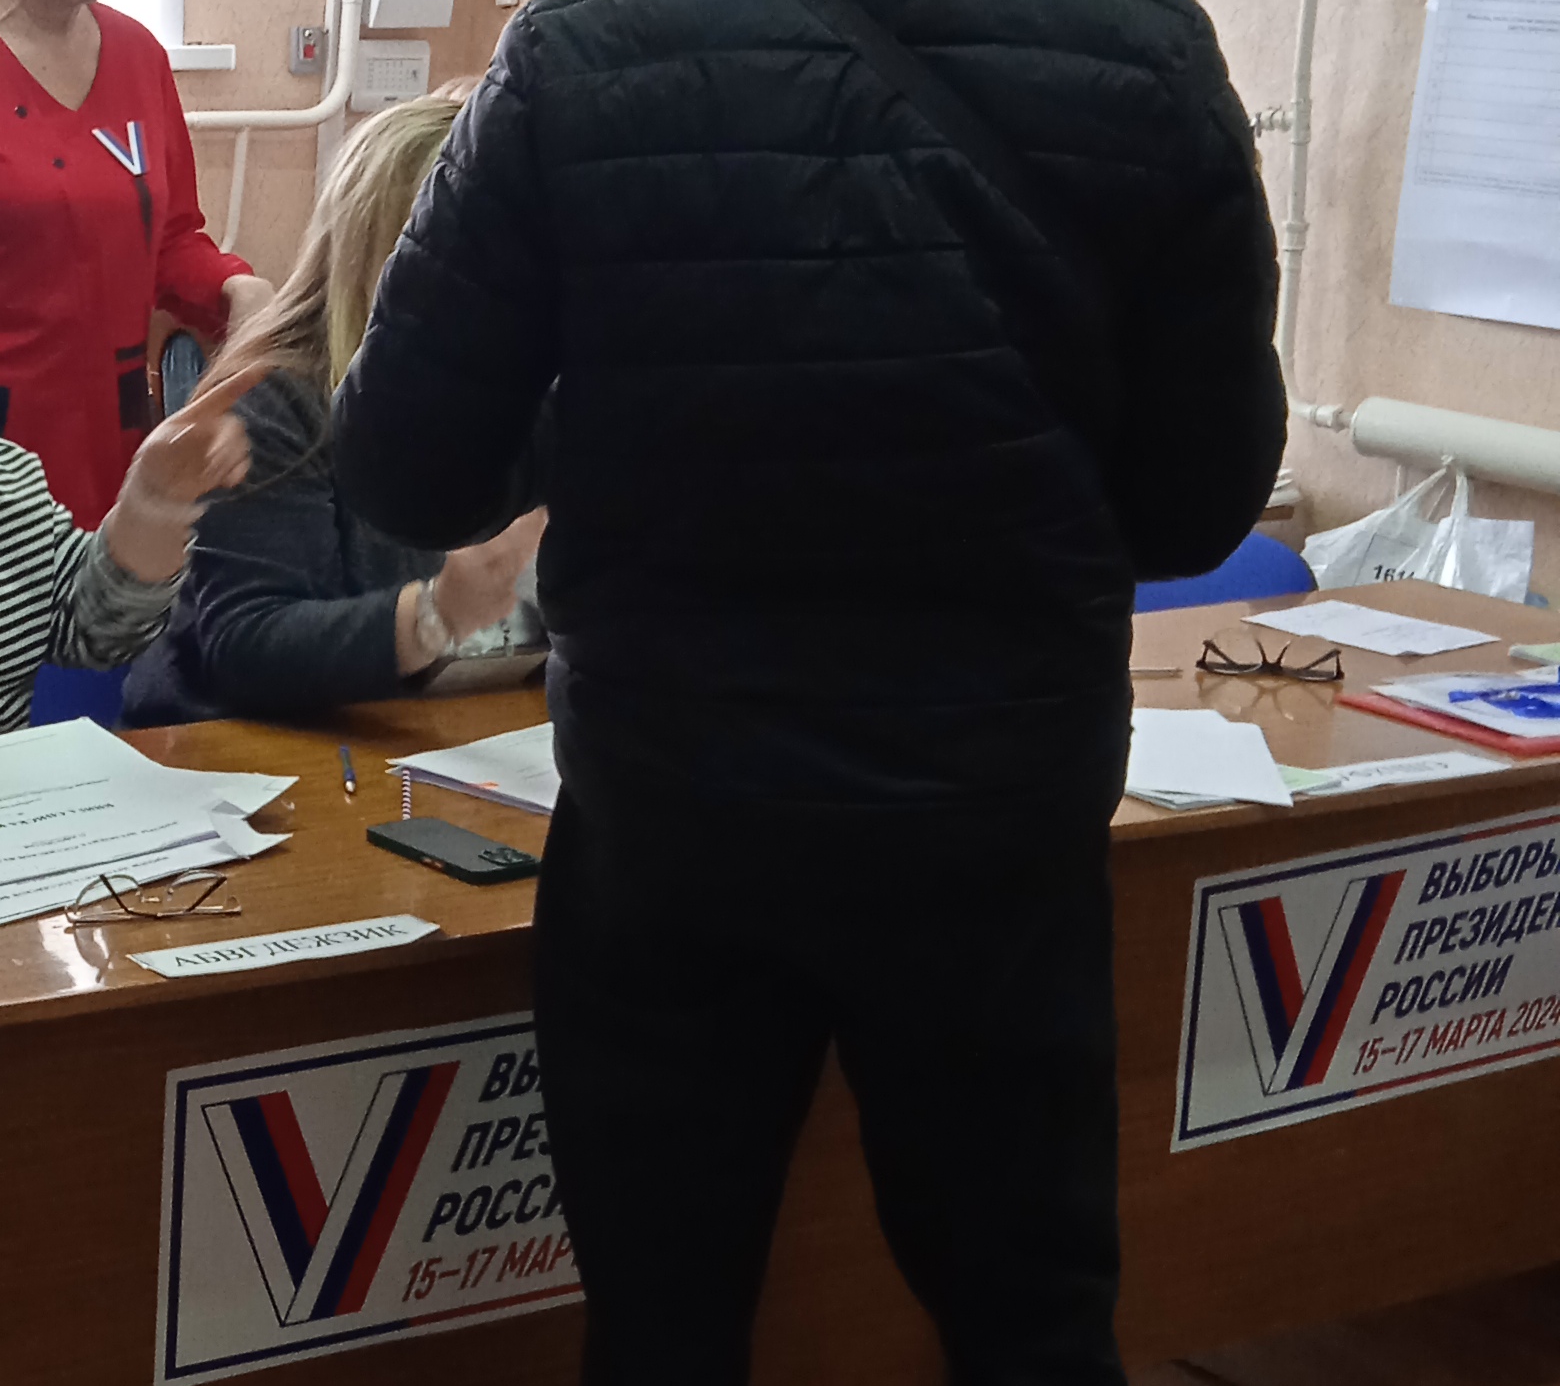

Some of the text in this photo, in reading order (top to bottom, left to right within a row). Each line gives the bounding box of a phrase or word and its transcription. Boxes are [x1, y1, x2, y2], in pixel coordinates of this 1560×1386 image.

[1370, 955, 1514, 1025] РОССИИ
[1422, 1009, 1507, 1059] МАРТА
[496, 1231, 578, 1283] МАР
